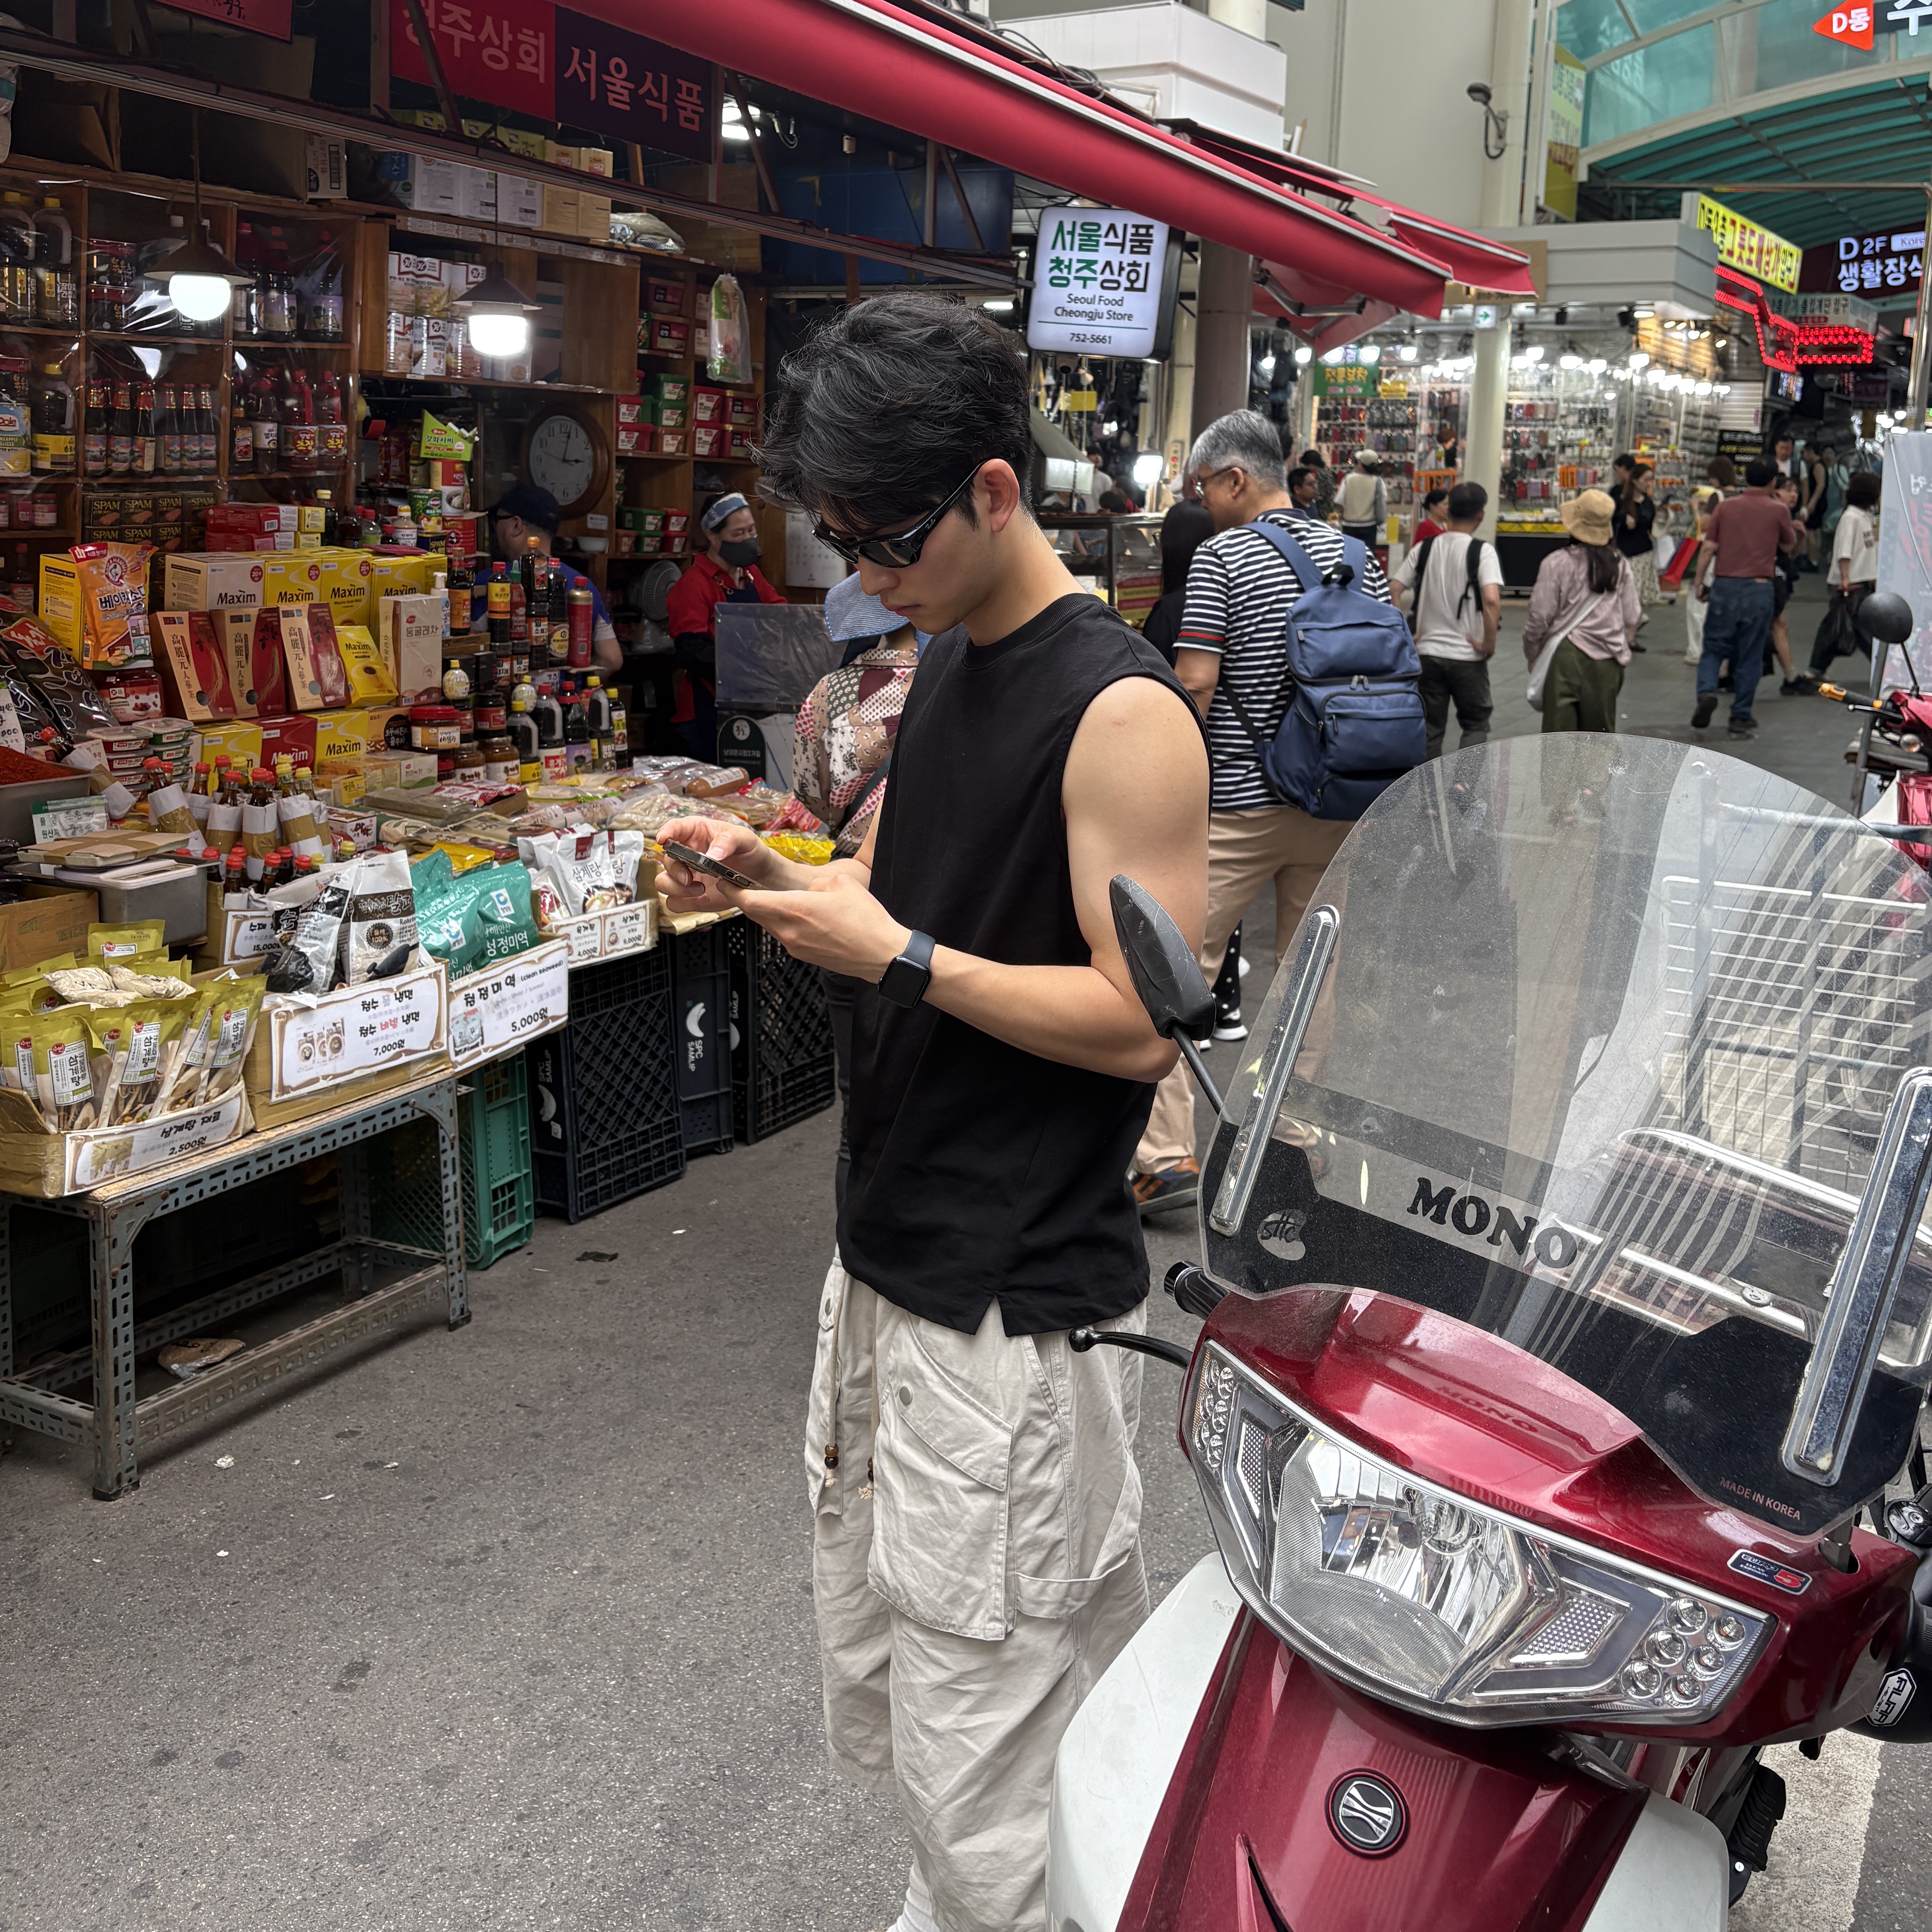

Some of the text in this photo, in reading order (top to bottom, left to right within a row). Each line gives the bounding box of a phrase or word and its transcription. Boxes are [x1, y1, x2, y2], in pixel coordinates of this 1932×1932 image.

[1832, 7, 1871, 34] D동
[564, 46, 704, 132] 서울식품
[1051, 221, 1155, 255] 서울식품
[1839, 237, 1859, 260] D
[1862, 236, 1888, 255] 2F
[1049, 257, 1150, 293] 청주상회
[1067, 294, 1124, 307] Seoul Food
[1054, 307, 1133, 321] Cheongju Store
[1069, 332, 1112, 344] 752-5661
[93, 501, 120, 510] SPAM
[125, 500, 152, 508] SPAM
[159, 498, 181, 506] SPAM
[191, 497, 213, 505] SPAM
[93, 530, 118, 539] SPAM
[124, 529, 152, 537] SPAM
[159, 527, 181, 535] SPAM
[217, 590, 256, 605] Maxim
[277, 588, 313, 603] Maxim
[331, 584, 364, 599] Maxim
[384, 585, 416, 596] Maxim
[406, 626, 438, 637] 둥굴레차
[345, 641, 370, 650] Maxim
[326, 739, 361, 756] Maxim
[271, 748, 308, 764] Mxim
[573, 862, 601, 882] 삼계탕
[395, 989, 413, 1003] 냉면
[380, 1017, 398, 1030] 비빔
[402, 1011, 419, 1025] 냉면
[511, 1007, 548, 1032] 5,000원
[142, 1036, 152, 1067] 삼계탕
[373, 1039, 405, 1056] 7,000원
[695, 1039, 703, 1059] SPC
[69, 1054, 80, 1087] 삼계탕
[161, 1111, 221, 1138] 삼계탕 재료
[168, 1136, 207, 1156] 2,500원
[1407, 1176, 1577, 1269] MONO
[1720, 1478, 1800, 1520] MADE IN KOREA
[1741, 1554, 1805, 1588] EURO 5
